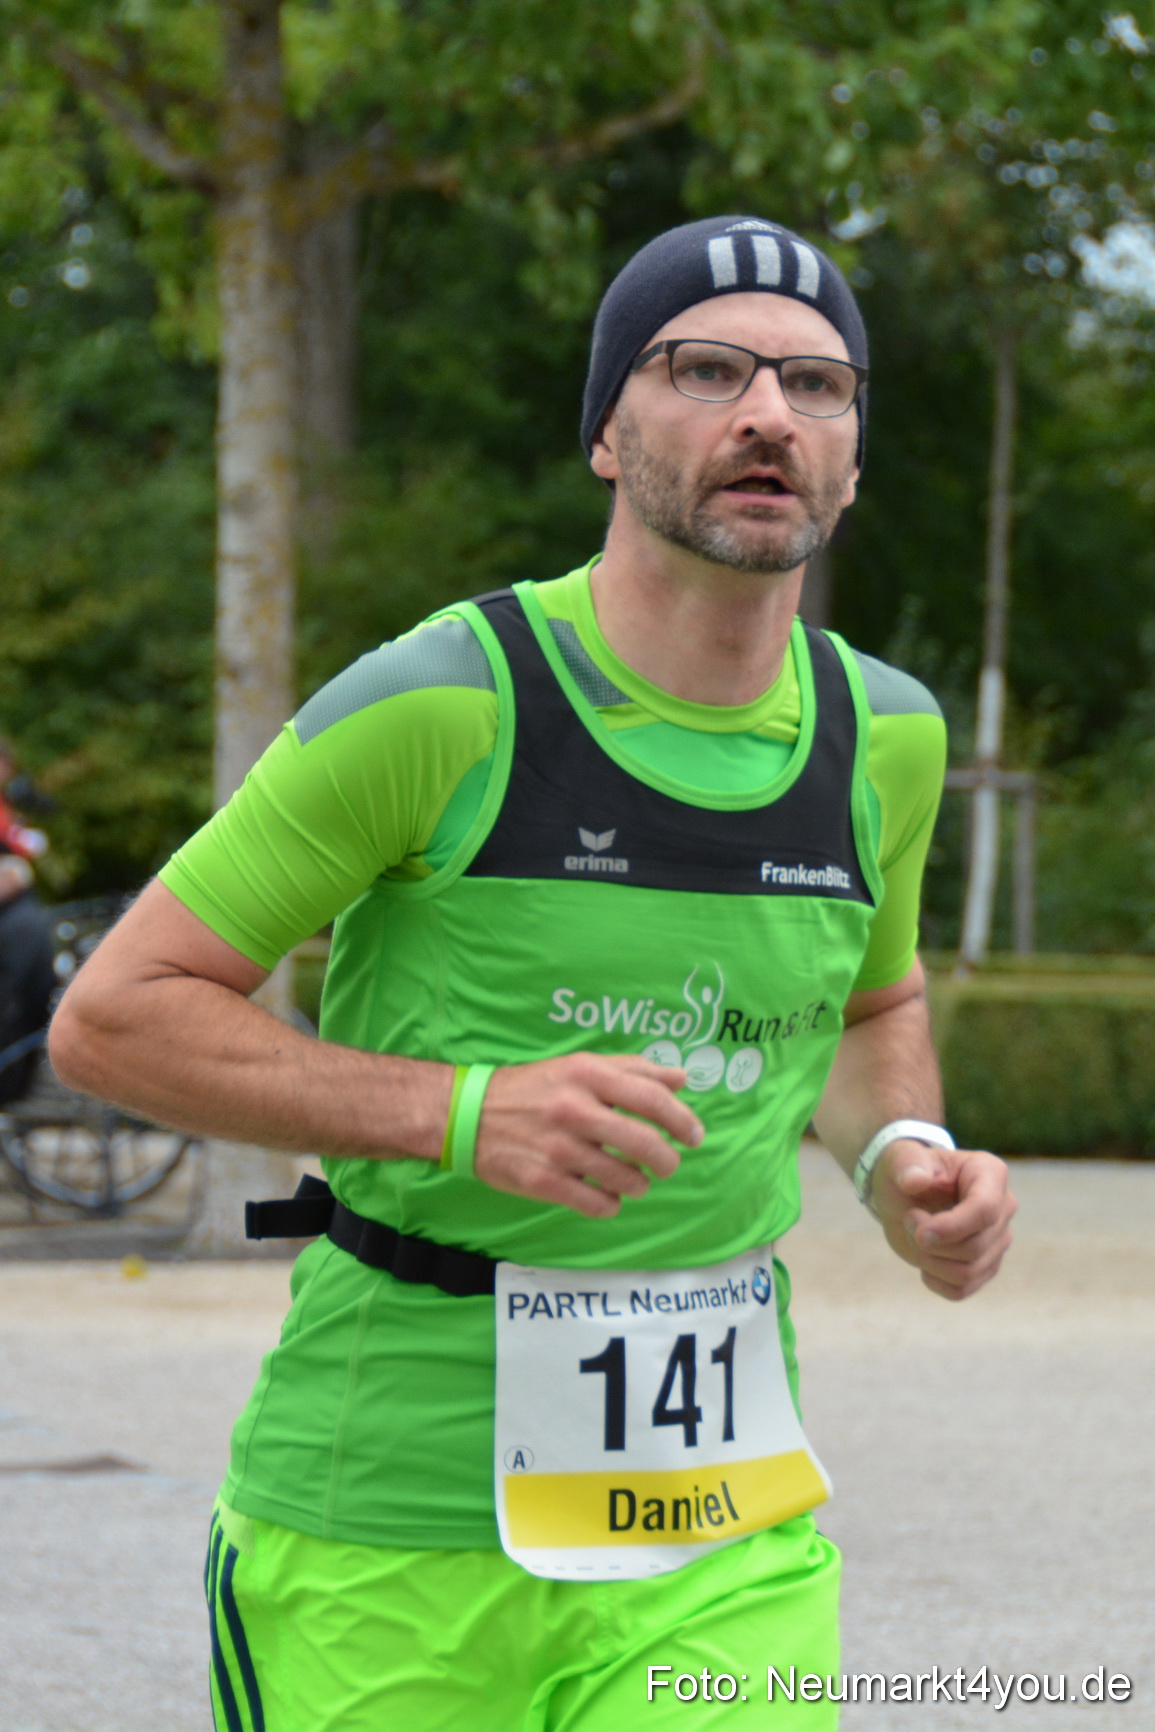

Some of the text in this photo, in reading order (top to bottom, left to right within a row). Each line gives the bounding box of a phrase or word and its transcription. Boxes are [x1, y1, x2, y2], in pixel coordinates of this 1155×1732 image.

[564, 854, 629, 873] erima
[761, 861, 851, 889] FrankenBlitz
[548, 988, 693, 1037] SoWiso
[507, 1278, 747, 1320] PARTL Neumarkt
[579, 1326, 737, 1452] 141
[512, 1450, 526, 1470] A
[608, 1480, 740, 1532] Daniel
